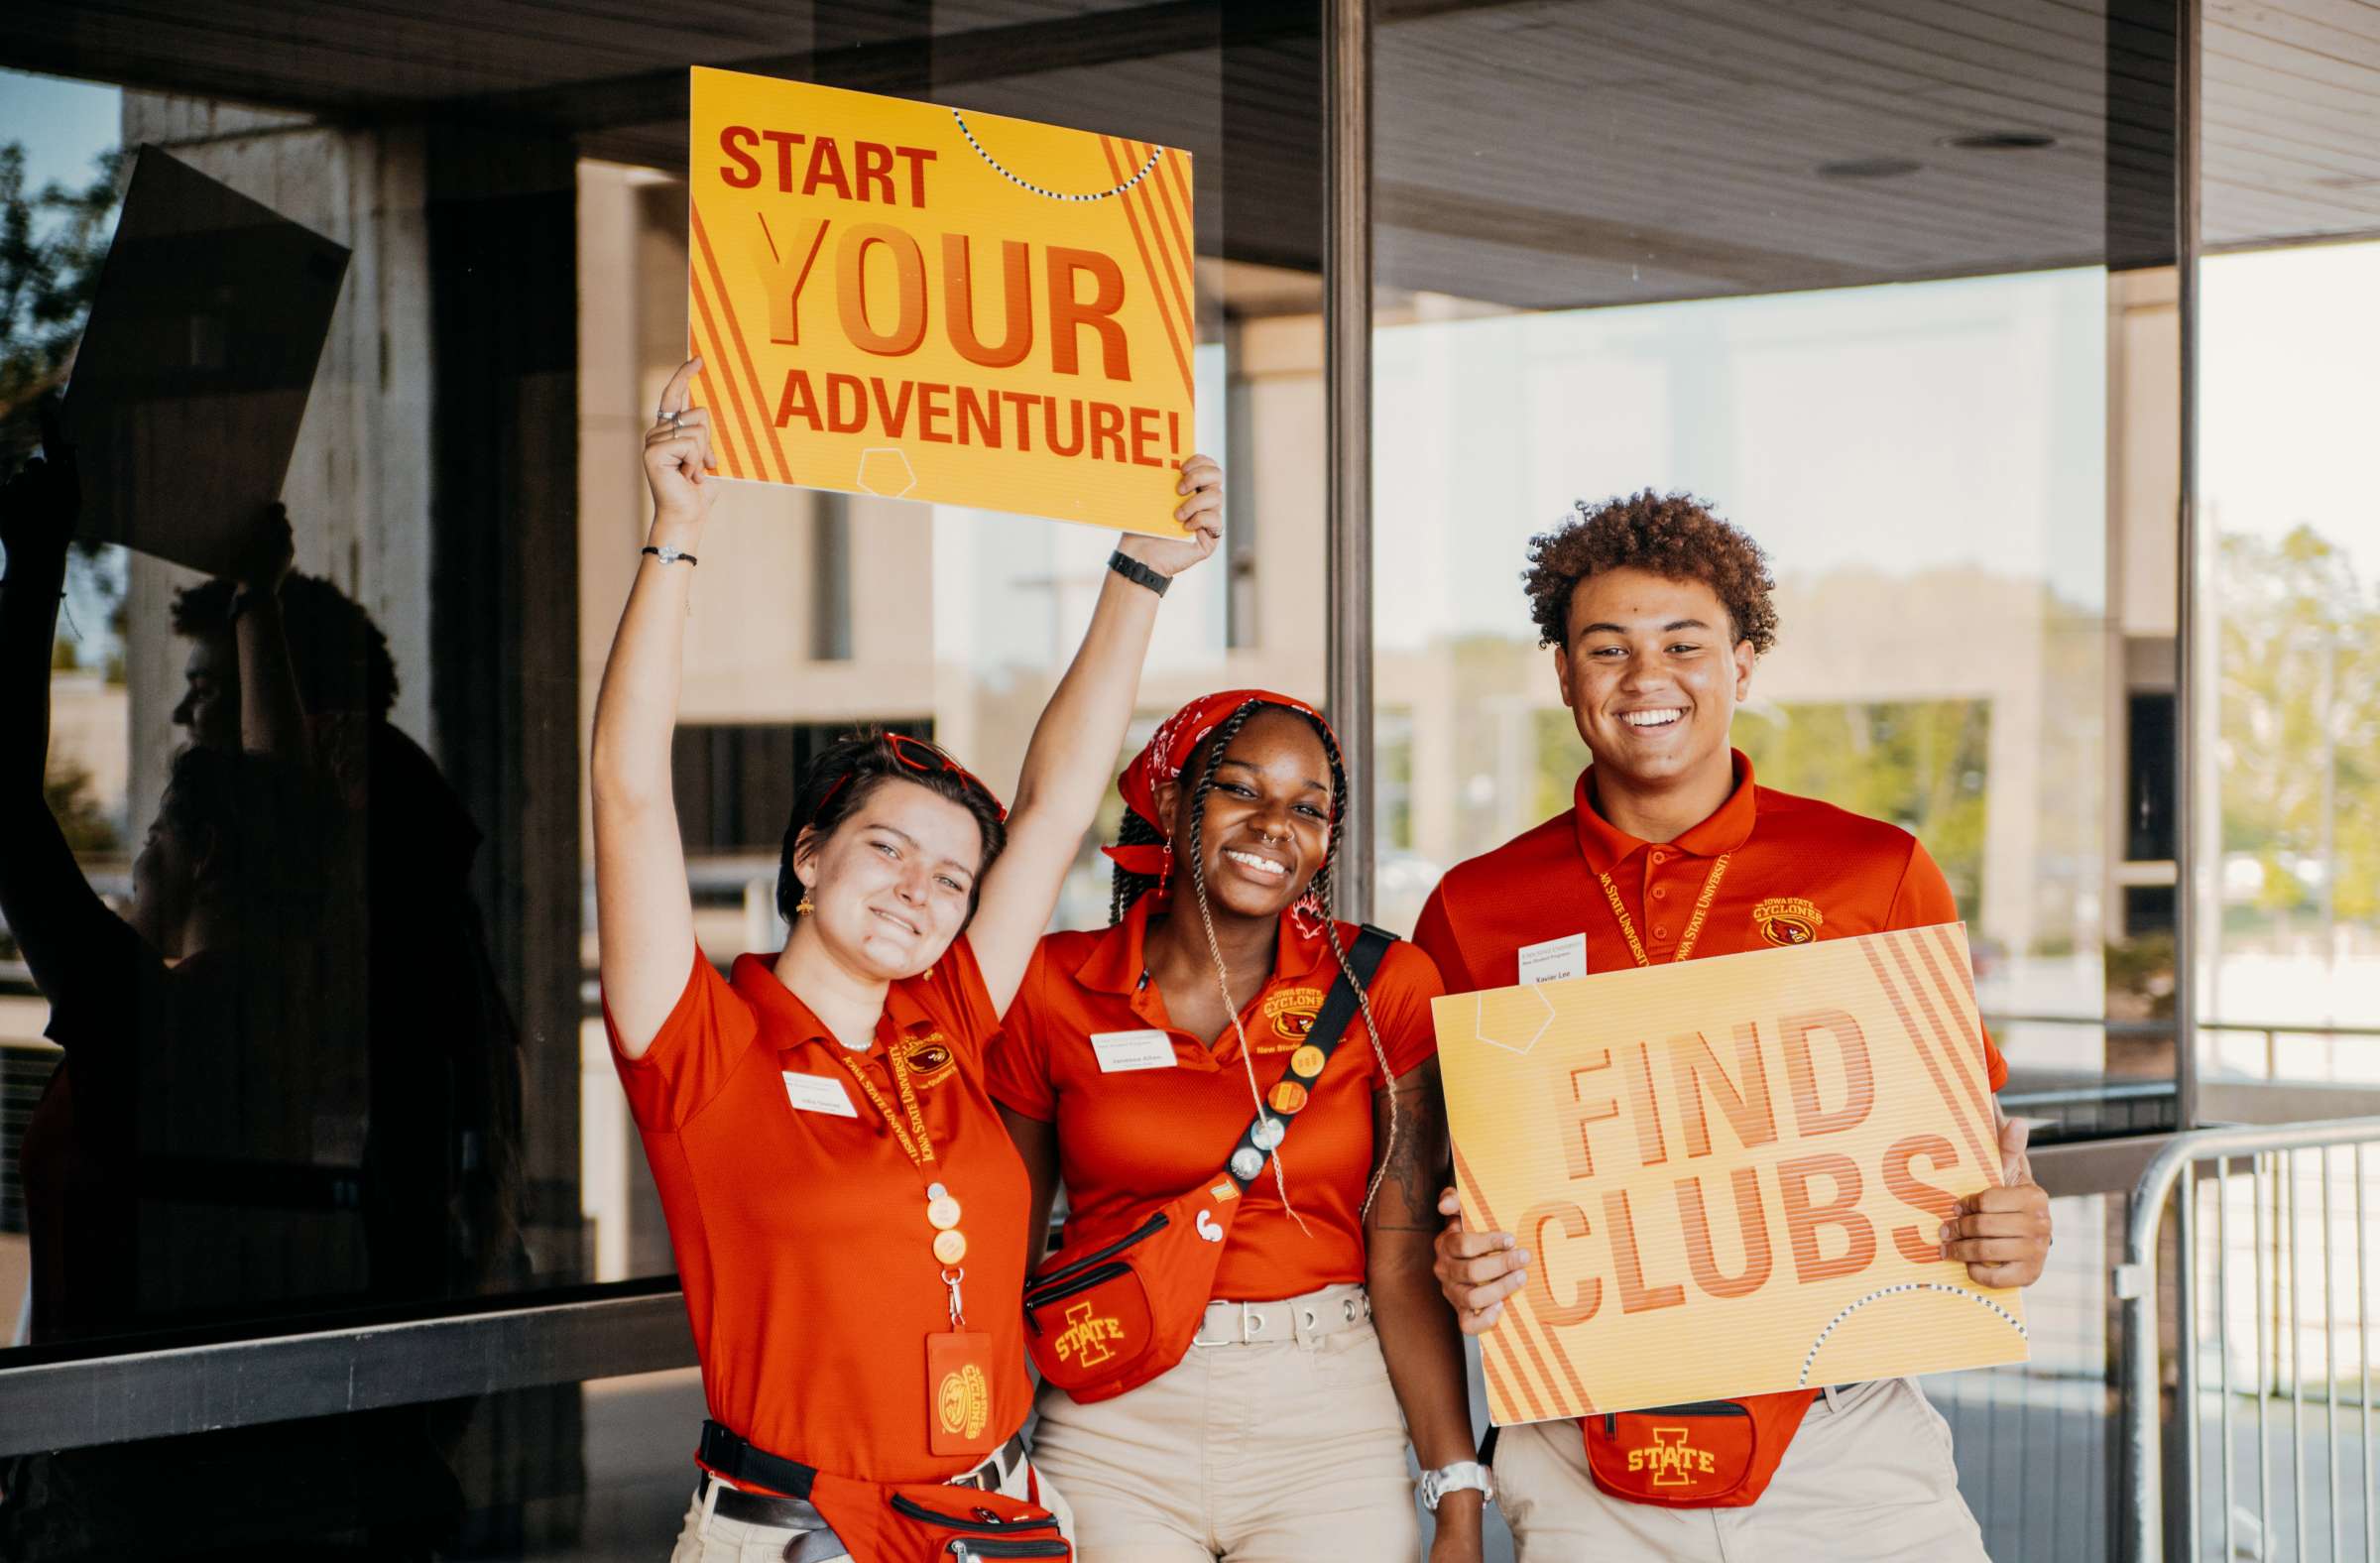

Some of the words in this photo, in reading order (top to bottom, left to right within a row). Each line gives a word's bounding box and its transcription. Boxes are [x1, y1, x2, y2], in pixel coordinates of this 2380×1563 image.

[718, 125, 937, 208] START
[751, 211, 1132, 382] YOUR
[774, 369, 1182, 470] ADVENTURE!
[1606, 885, 1625, 915] STATE
[1753, 904, 1824, 924] CYCLONES
[1764, 898, 1786, 906] IOWA
[1787, 898, 1814, 908] STATE
[1684, 908, 1706, 940] STATE
[1264, 995, 1324, 1016] CYCLONE
[889, 1044, 914, 1103] UNIVERSITY
[1547, 1008, 1875, 1181] FIND
[907, 1104, 925, 1133] STATE
[917, 1133, 934, 1161] IOWA
[1518, 1133, 1964, 1327] CLUBS
[1054, 1318, 1125, 1362] STATE
[965, 1364, 981, 1439] CYCLONES
[1627, 1446, 1715, 1474] STATE
